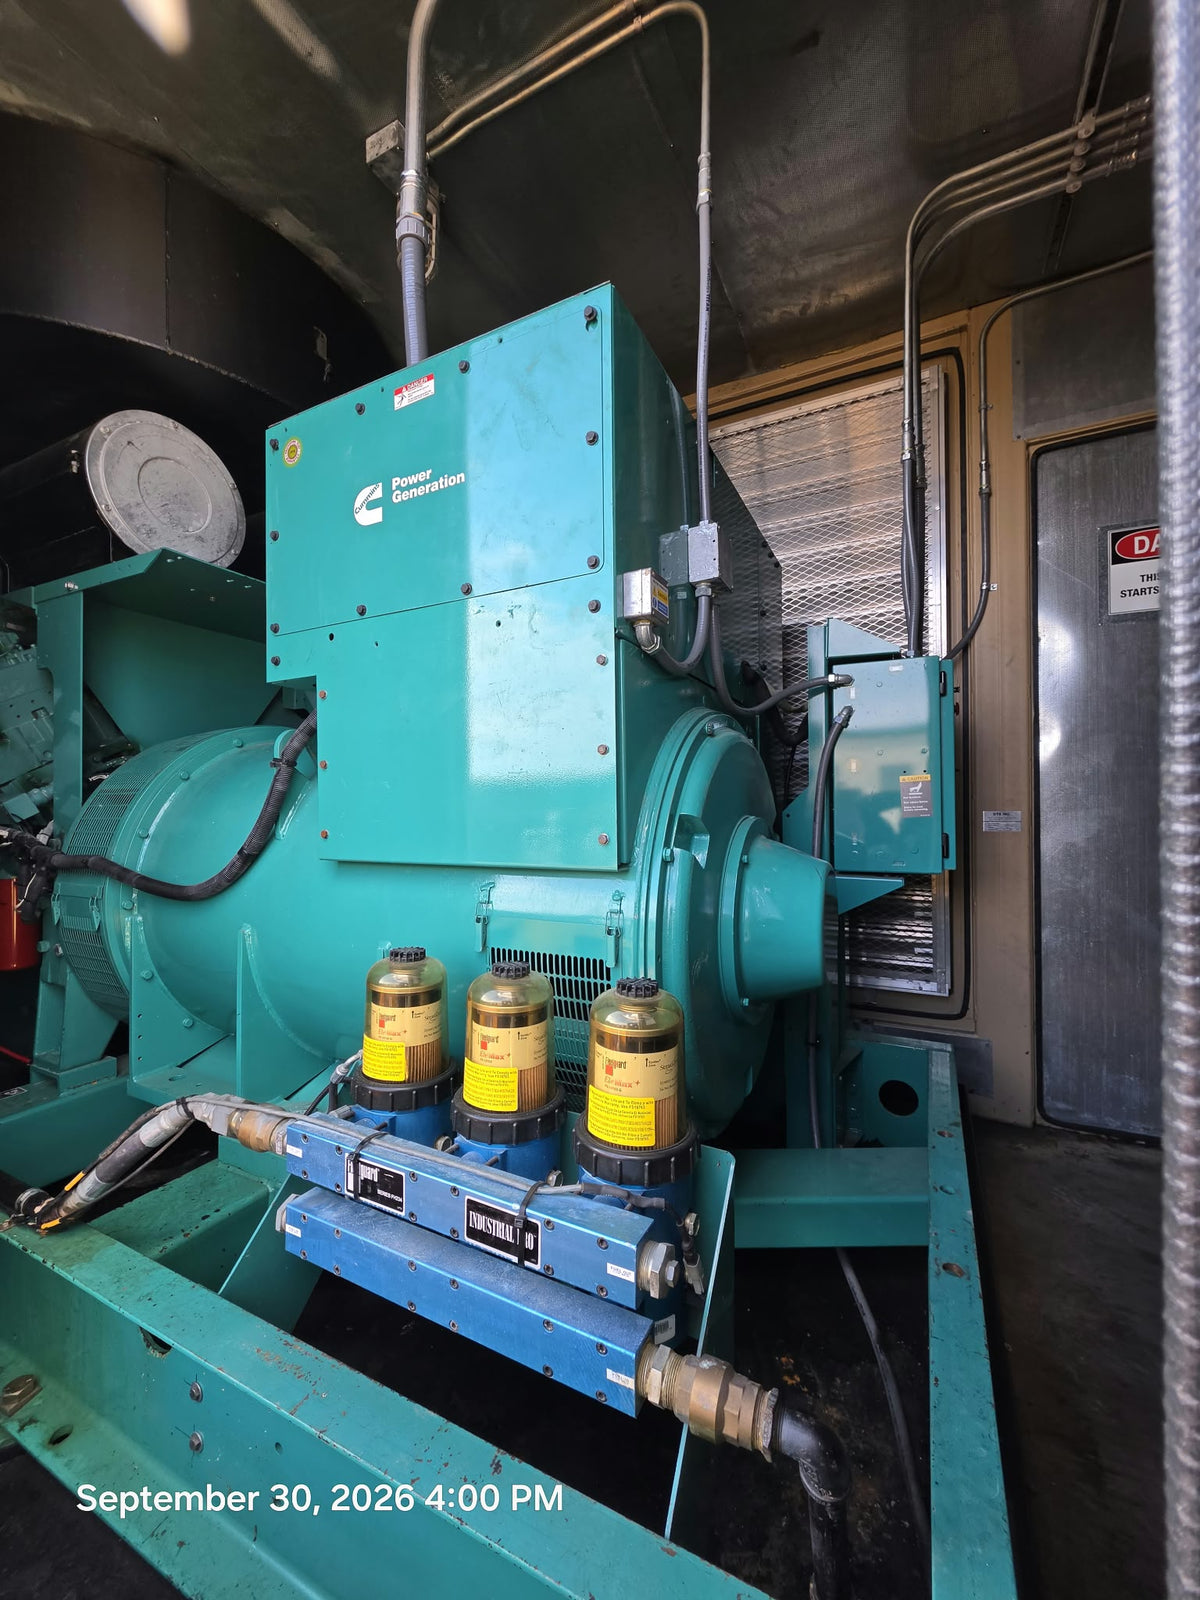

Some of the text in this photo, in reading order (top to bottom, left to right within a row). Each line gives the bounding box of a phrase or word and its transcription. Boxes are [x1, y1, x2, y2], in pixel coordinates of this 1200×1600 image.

[391, 468, 432, 490] Power
[391, 472, 465, 504] Generation
[354, 483, 380, 514] Cummins
[1120, 585, 1160, 598] STARTS
[469, 1210, 514, 1243] INDUSTRIAL
